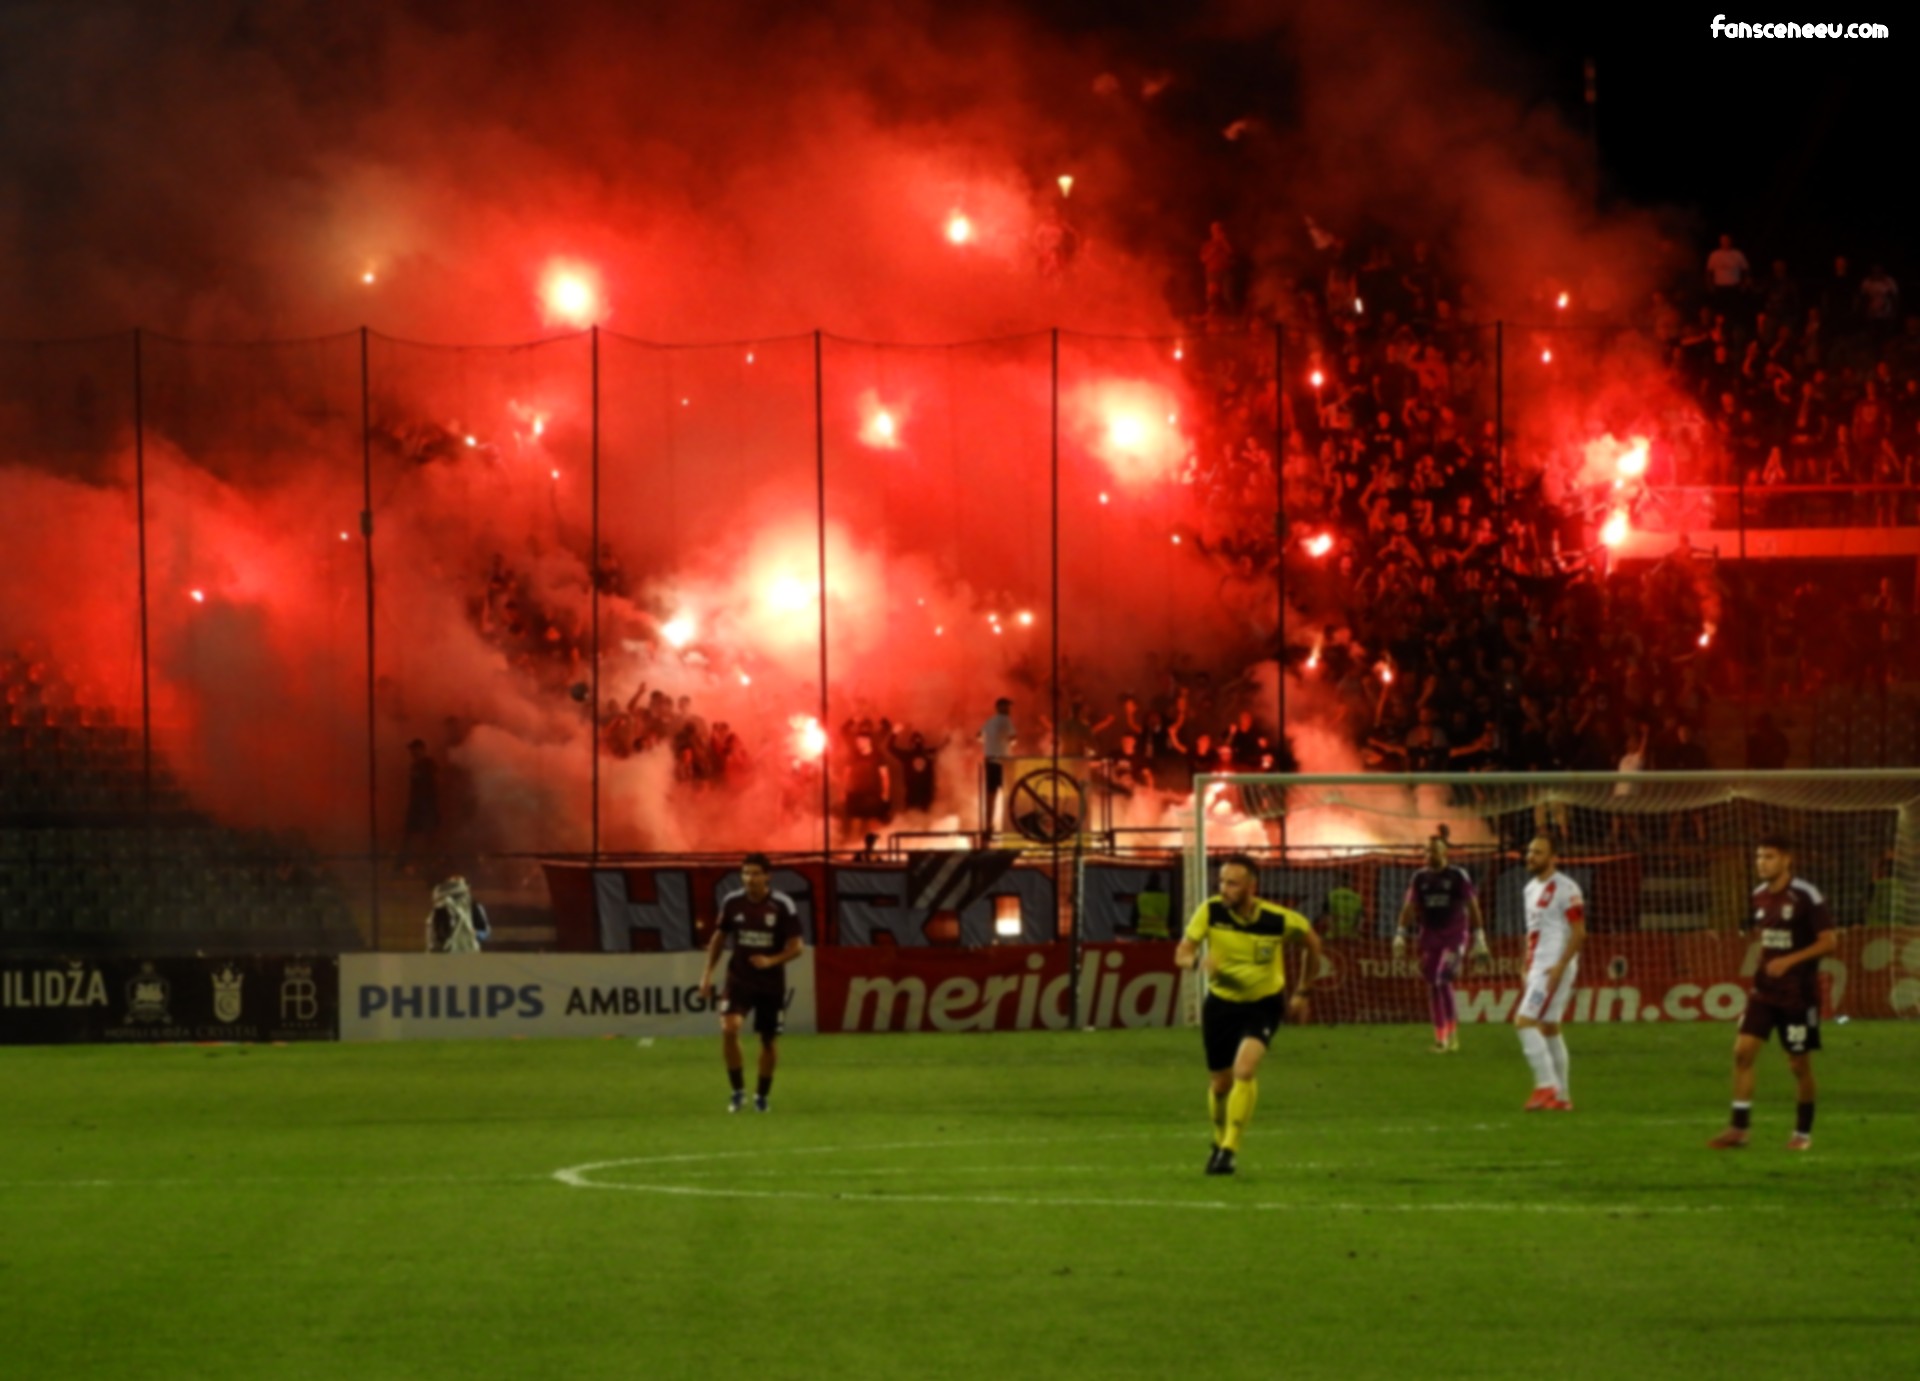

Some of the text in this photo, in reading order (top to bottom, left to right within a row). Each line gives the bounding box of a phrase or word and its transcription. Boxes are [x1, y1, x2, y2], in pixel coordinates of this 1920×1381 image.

[2, 961, 109, 1007] ILIDŽA
[358, 984, 543, 1018] PHILIPS
[195, 1025, 259, 1038] CRYSTAL
